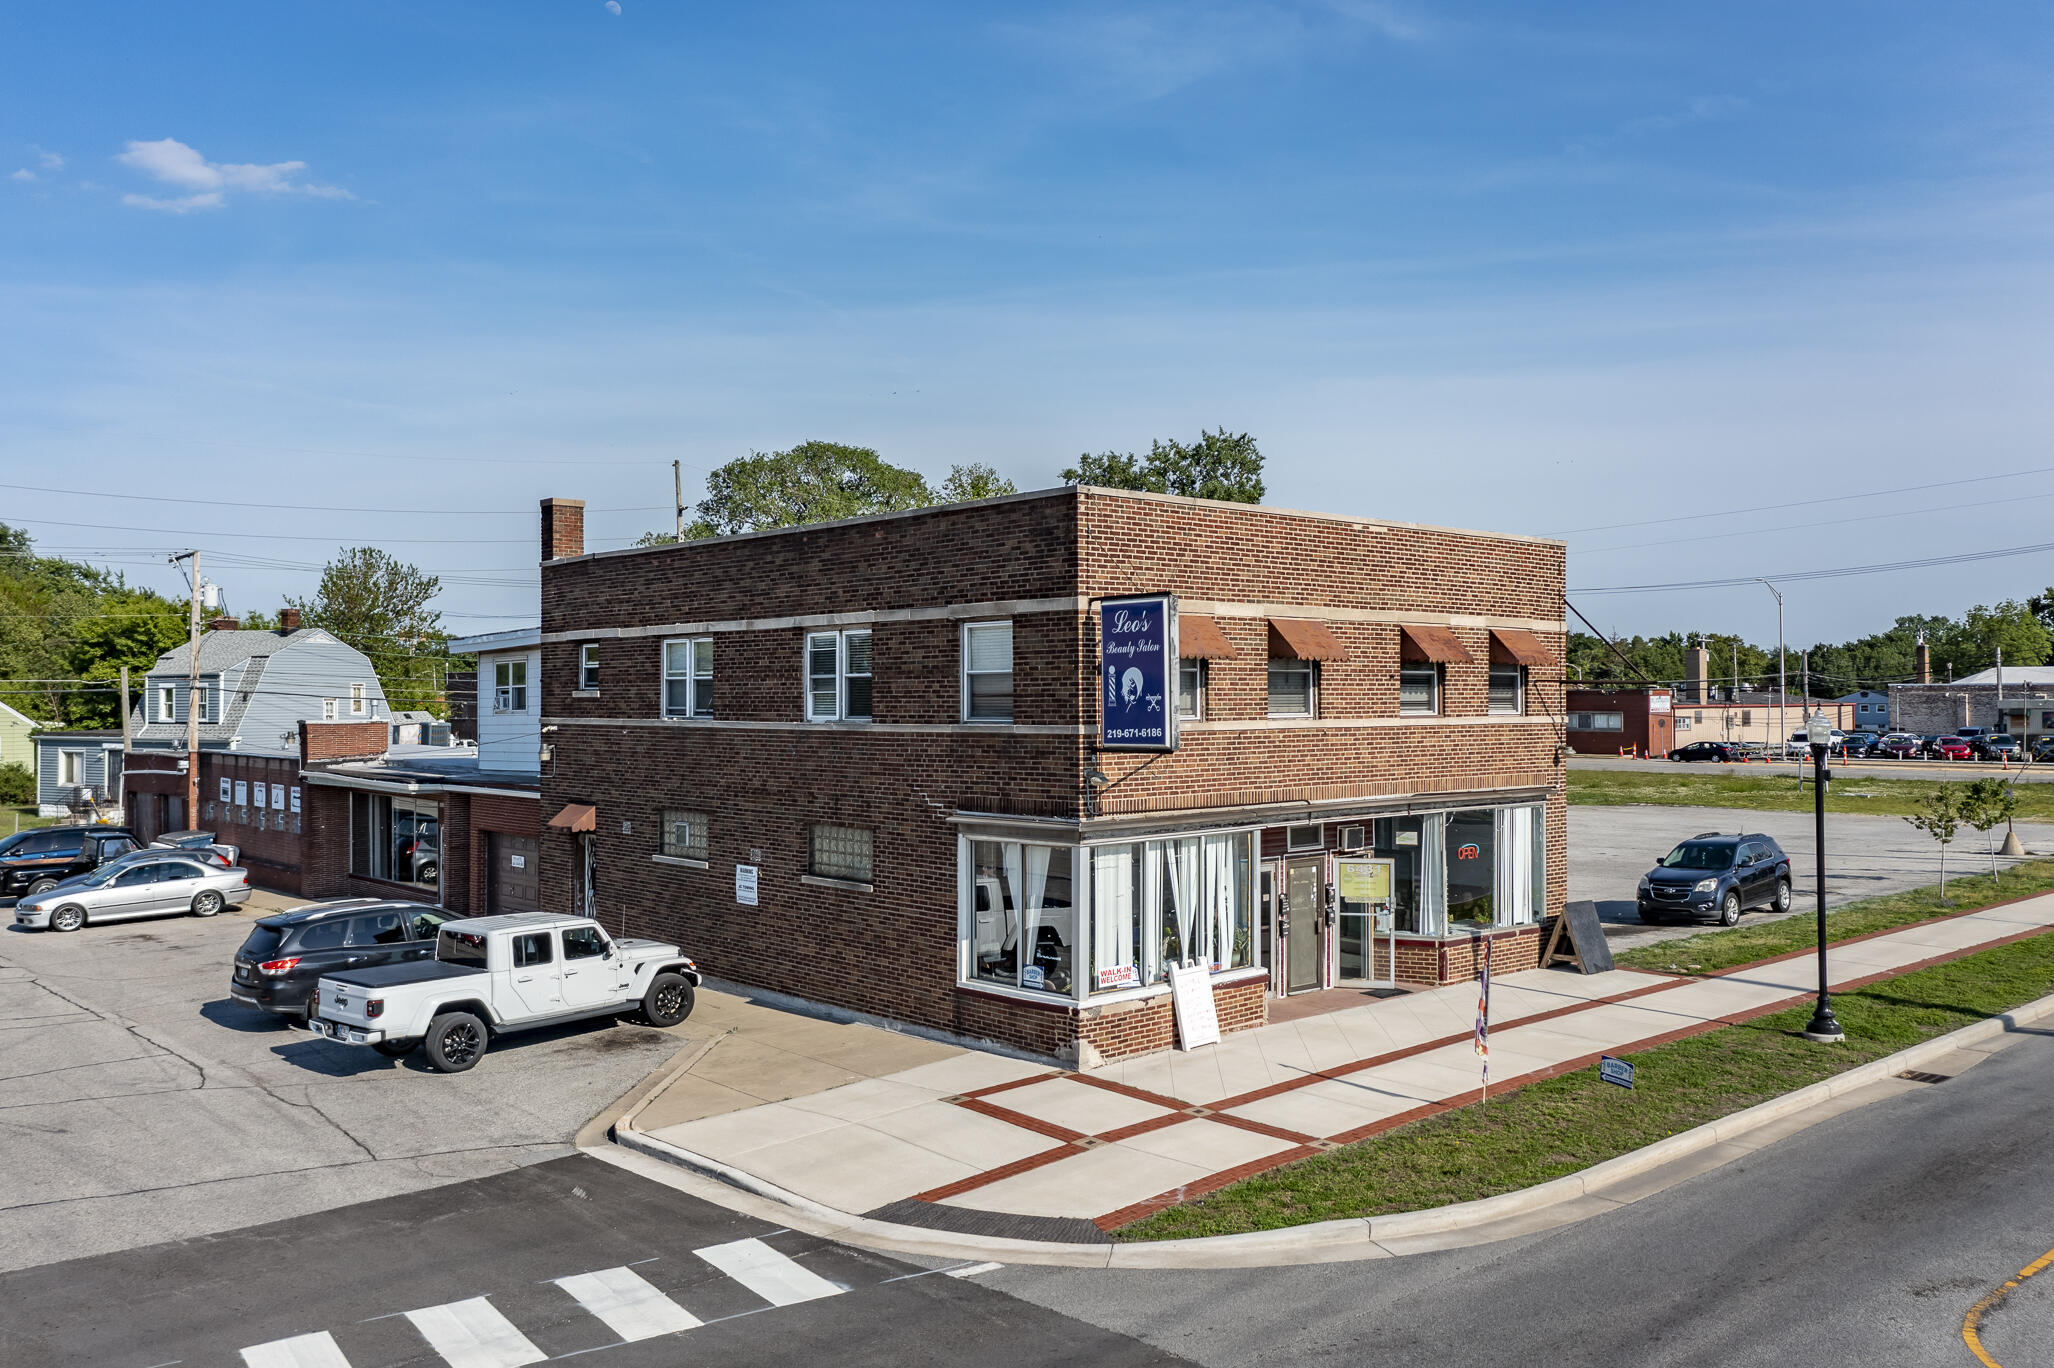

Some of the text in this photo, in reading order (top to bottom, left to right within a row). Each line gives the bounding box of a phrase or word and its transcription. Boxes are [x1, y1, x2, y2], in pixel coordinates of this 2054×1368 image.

[1111, 609, 1152, 633] Leo's
[1106, 639, 1160, 658] Beauty Salon
[1107, 727, 1162, 738] 219-671-6186
[1458, 847, 1478, 860] OPEN
[1100, 966, 1131, 977] WALK-IN
[1100, 973, 1131, 984] WELCOME
[334, 994, 348, 1007] Jeep
[1606, 1061, 1628, 1073] BARBER
[1610, 1067, 1625, 1076] SHOP
